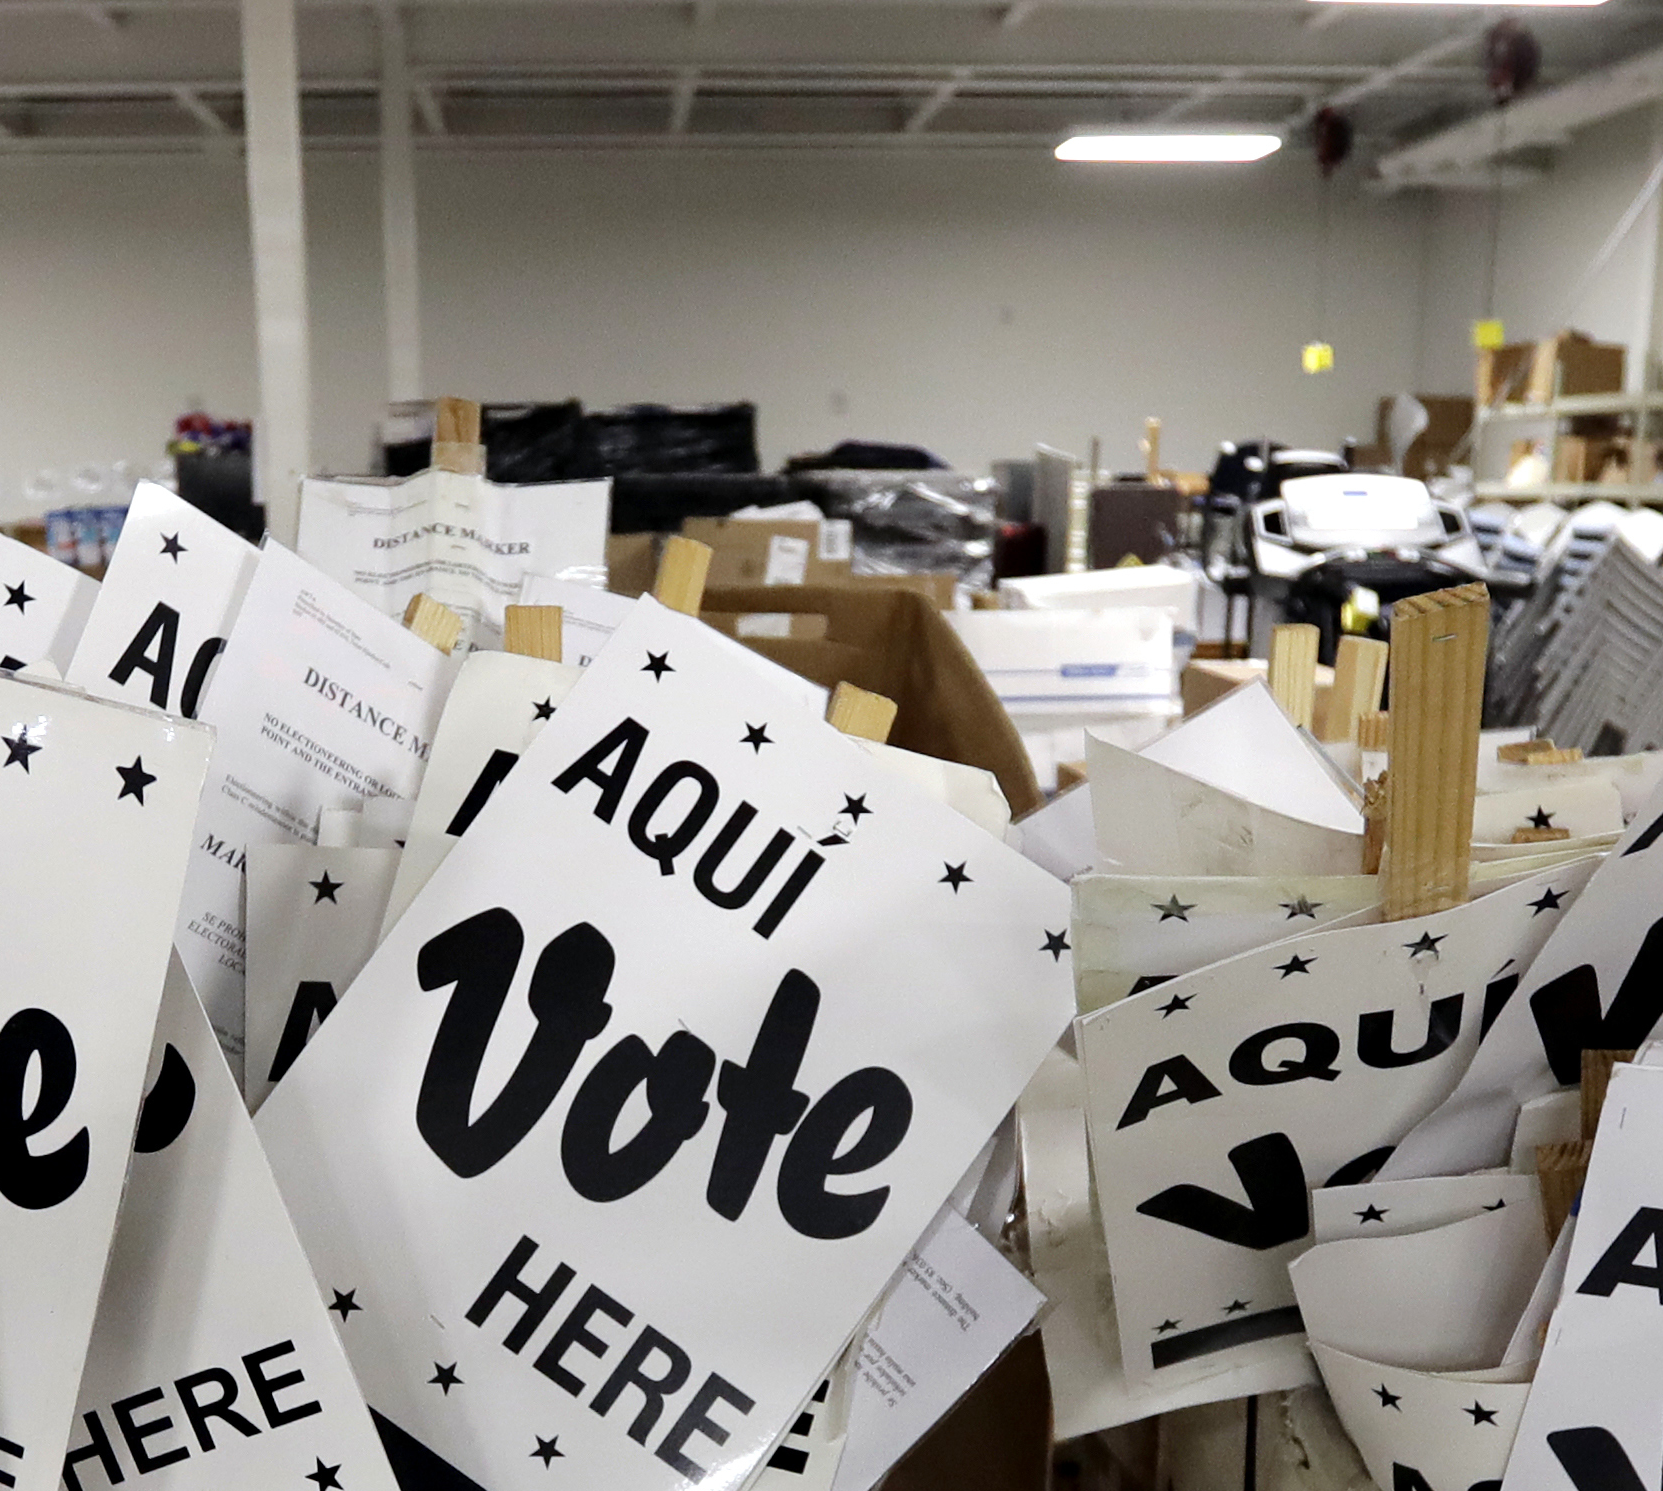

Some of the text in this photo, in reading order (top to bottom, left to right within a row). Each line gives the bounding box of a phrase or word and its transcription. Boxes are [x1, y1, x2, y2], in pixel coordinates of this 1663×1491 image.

[373, 521, 456, 550] DISTANCE
[303, 666, 408, 746] DISTANCE
[551, 717, 850, 940] AQUÍ
[416, 907, 913, 1240] Vote
[464, 1234, 757, 1486] HERE
